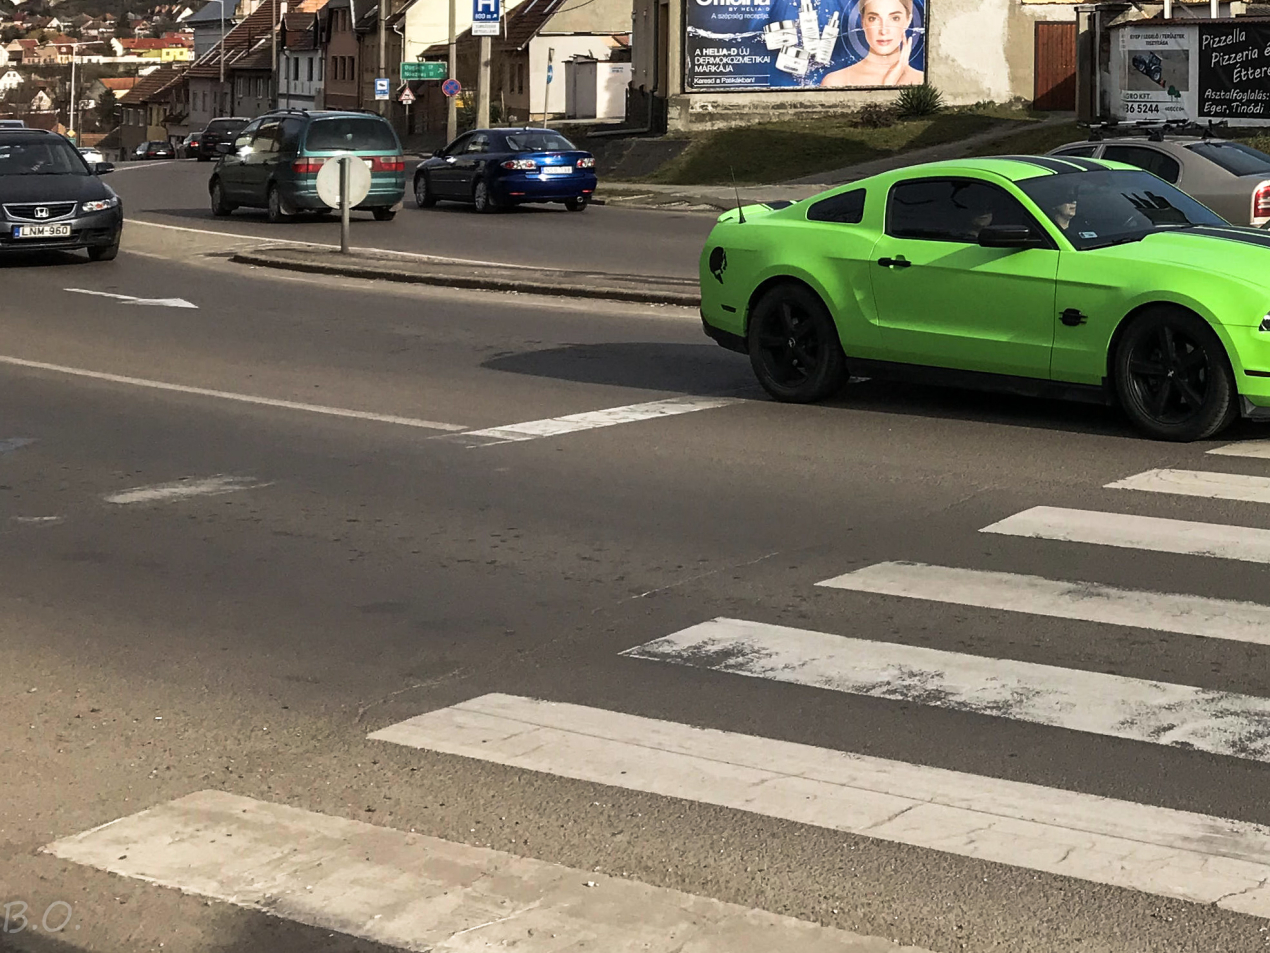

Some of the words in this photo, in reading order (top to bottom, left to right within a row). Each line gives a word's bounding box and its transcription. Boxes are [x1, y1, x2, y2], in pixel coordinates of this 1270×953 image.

[1202, 28, 1246, 49] Pizzella
[702, 48, 738, 56] HELIA-D
[739, 46, 750, 56] ÚJ
[694, 56, 771, 65] DERMOKOZMETIKAI
[1211, 47, 1259, 67] Pizzeria
[694, 63, 734, 73] MÁRKÁJA
[1204, 88, 1270, 101] Asztalfoglalás:
[1137, 104, 1160, 114] 5244
[21, 226, 68, 236] LNM-960
